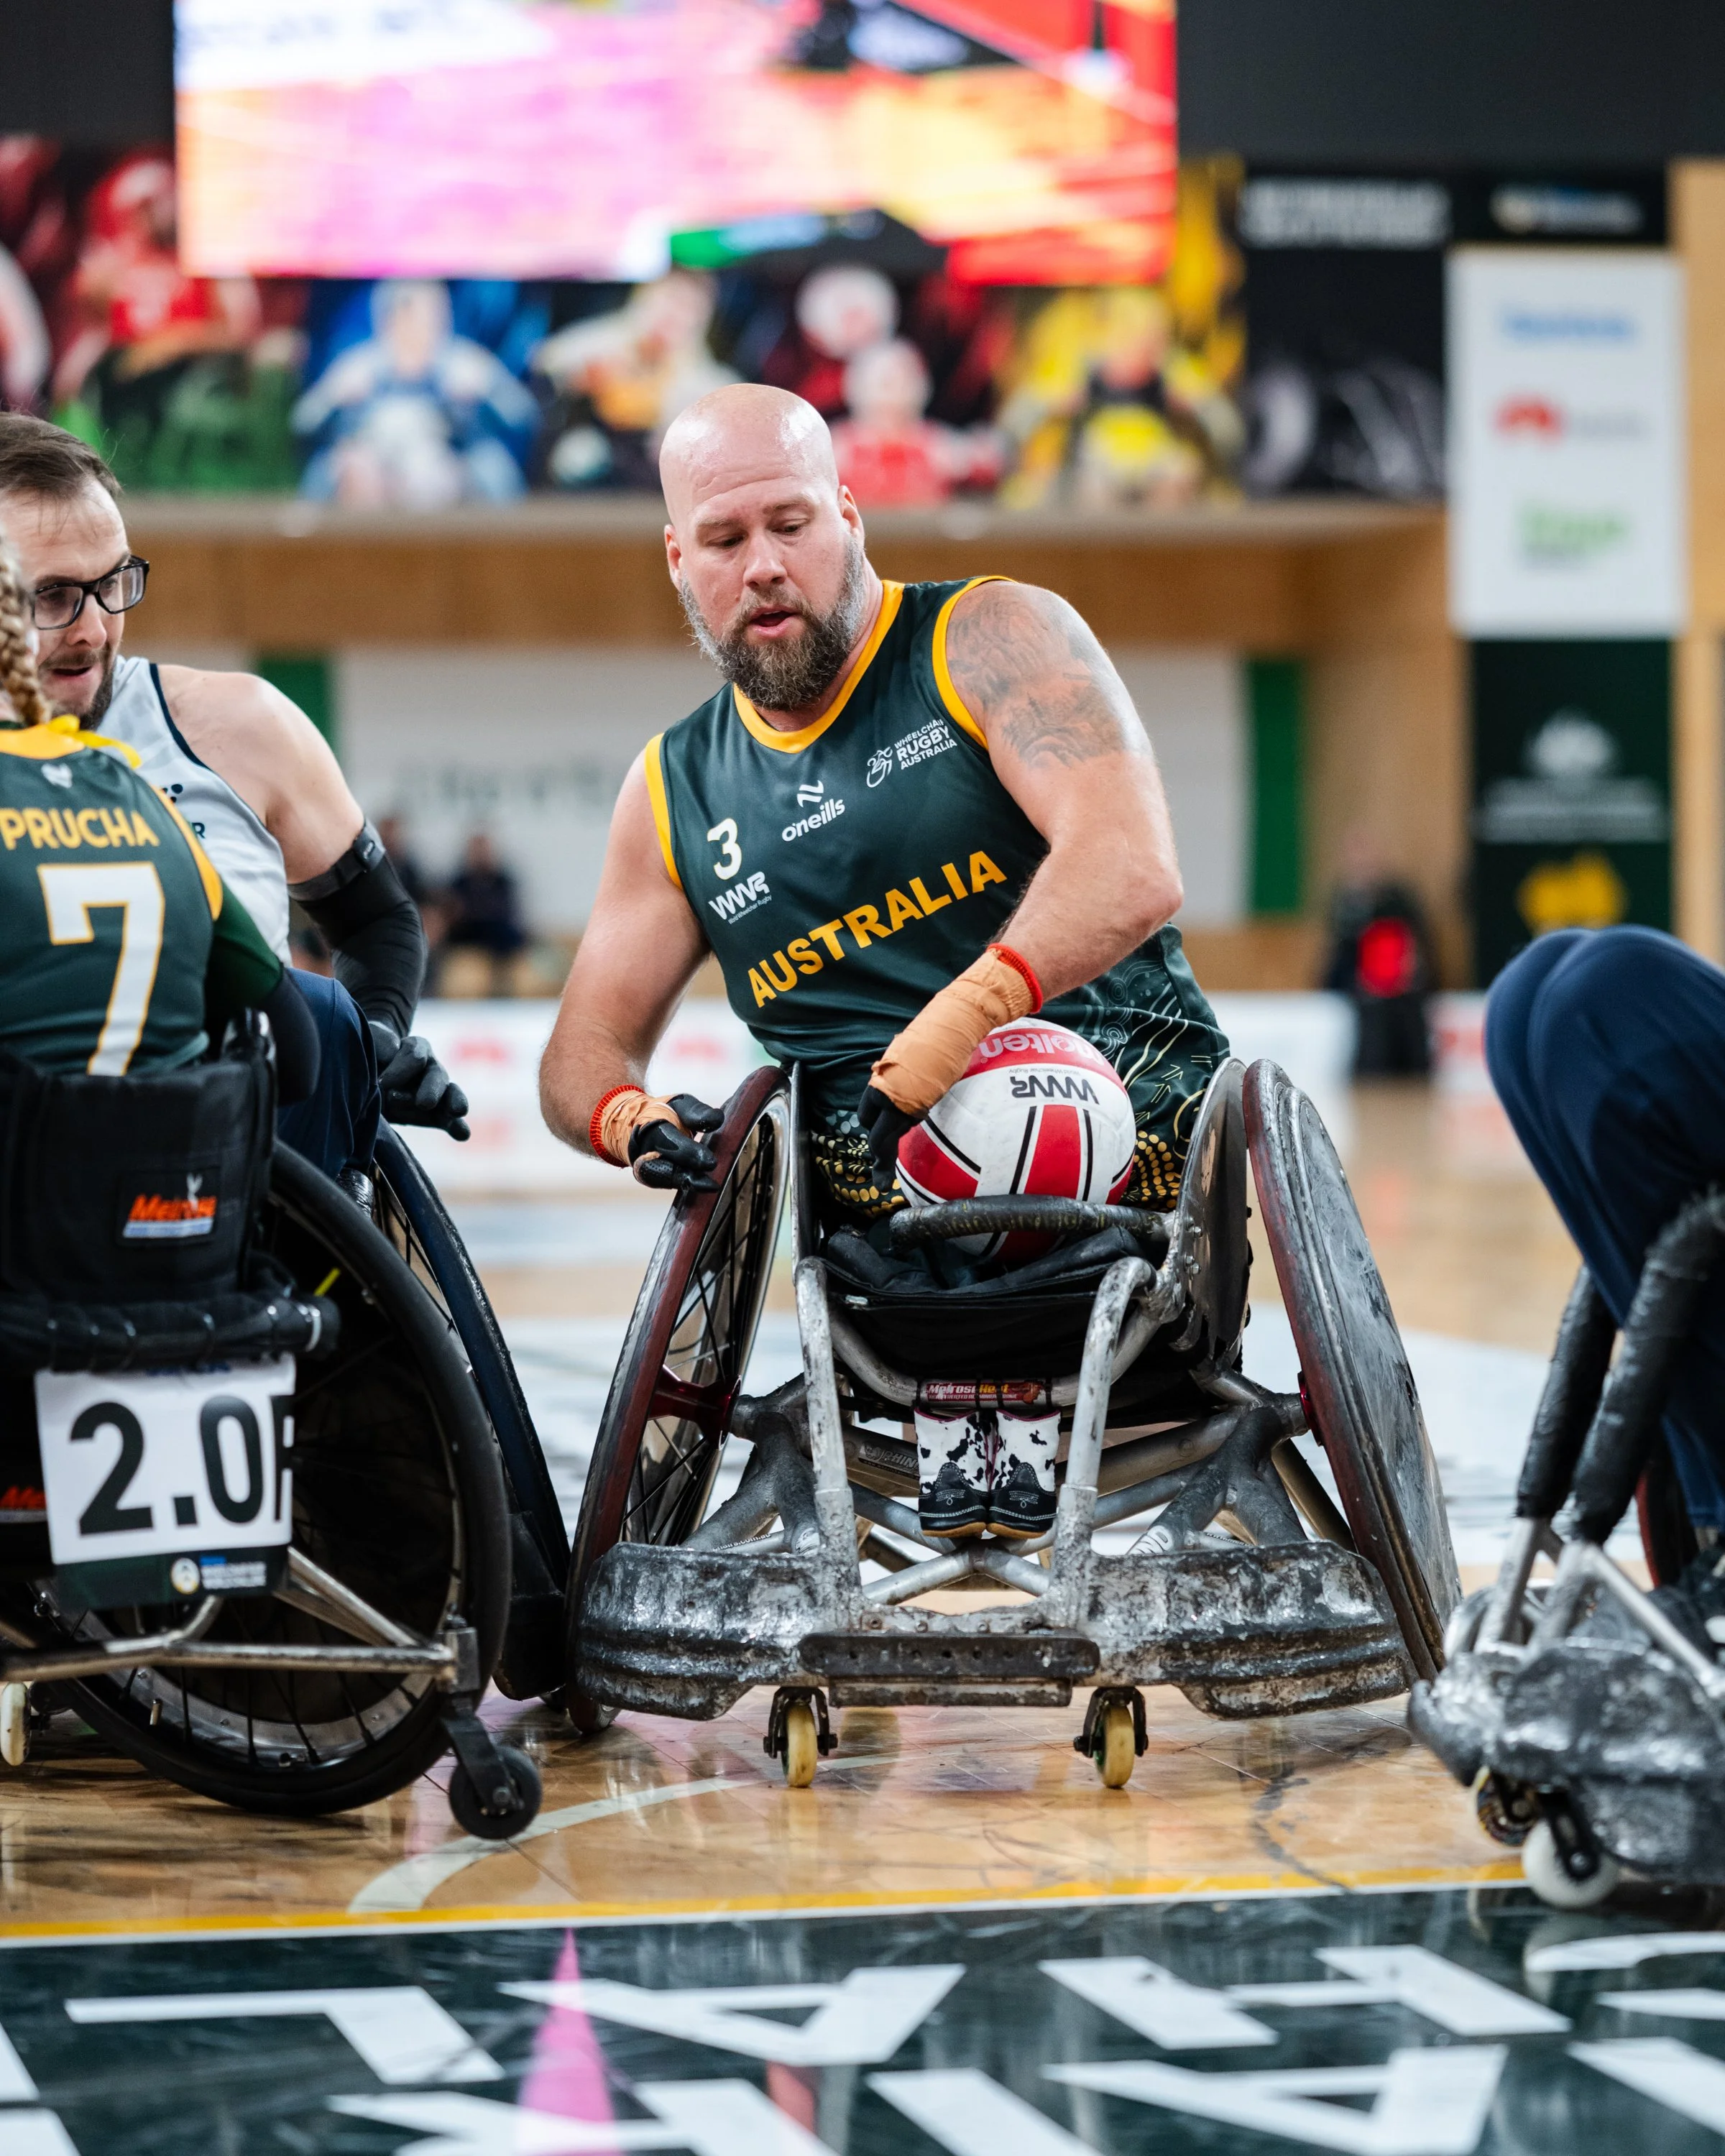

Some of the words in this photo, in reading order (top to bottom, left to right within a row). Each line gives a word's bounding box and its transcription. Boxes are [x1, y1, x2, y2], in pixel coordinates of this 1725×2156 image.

[896, 726, 949, 761] RUGBY
[901, 738, 957, 770] AUSTRALIA
[0, 807, 160, 850] PRUCHA
[707, 818, 742, 880] 3
[748, 851, 1007, 1008] AUSTRALIA
[37, 860, 165, 1077] 7
[978, 1033, 1105, 1066] molten
[979, 1383, 1009, 1393] Het
[883, 1450, 919, 1468] RHIN
